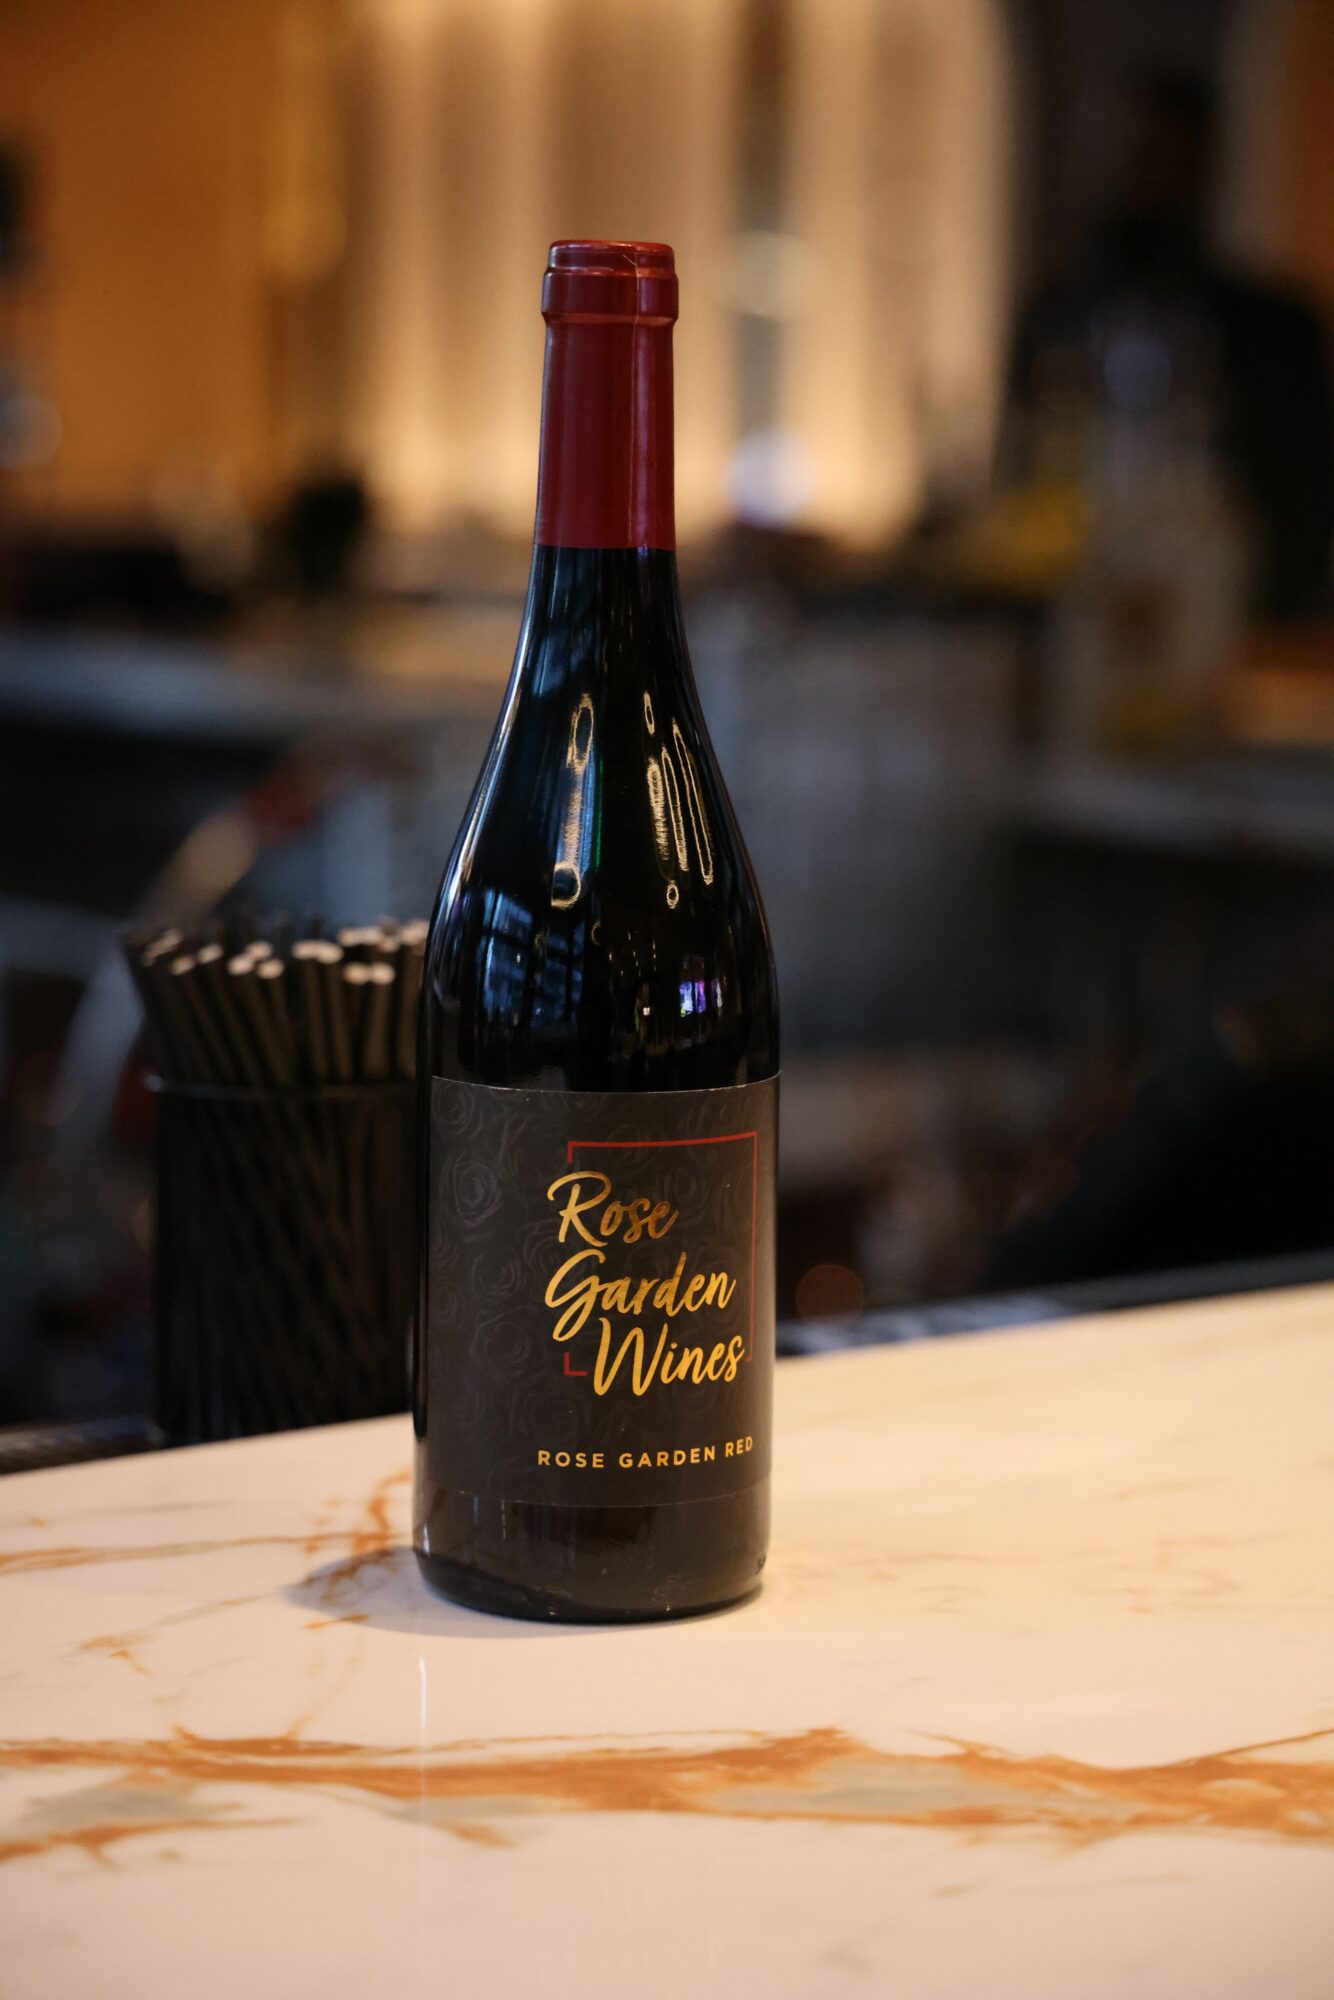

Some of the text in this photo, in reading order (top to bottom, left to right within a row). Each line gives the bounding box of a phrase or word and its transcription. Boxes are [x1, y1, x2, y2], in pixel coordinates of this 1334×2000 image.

[547, 1171, 679, 1247] Rose
[545, 1249, 736, 1342] Garden
[593, 1317, 745, 1396] Wines
[537, 1435, 753, 1469] ROSE GARDEN RED
